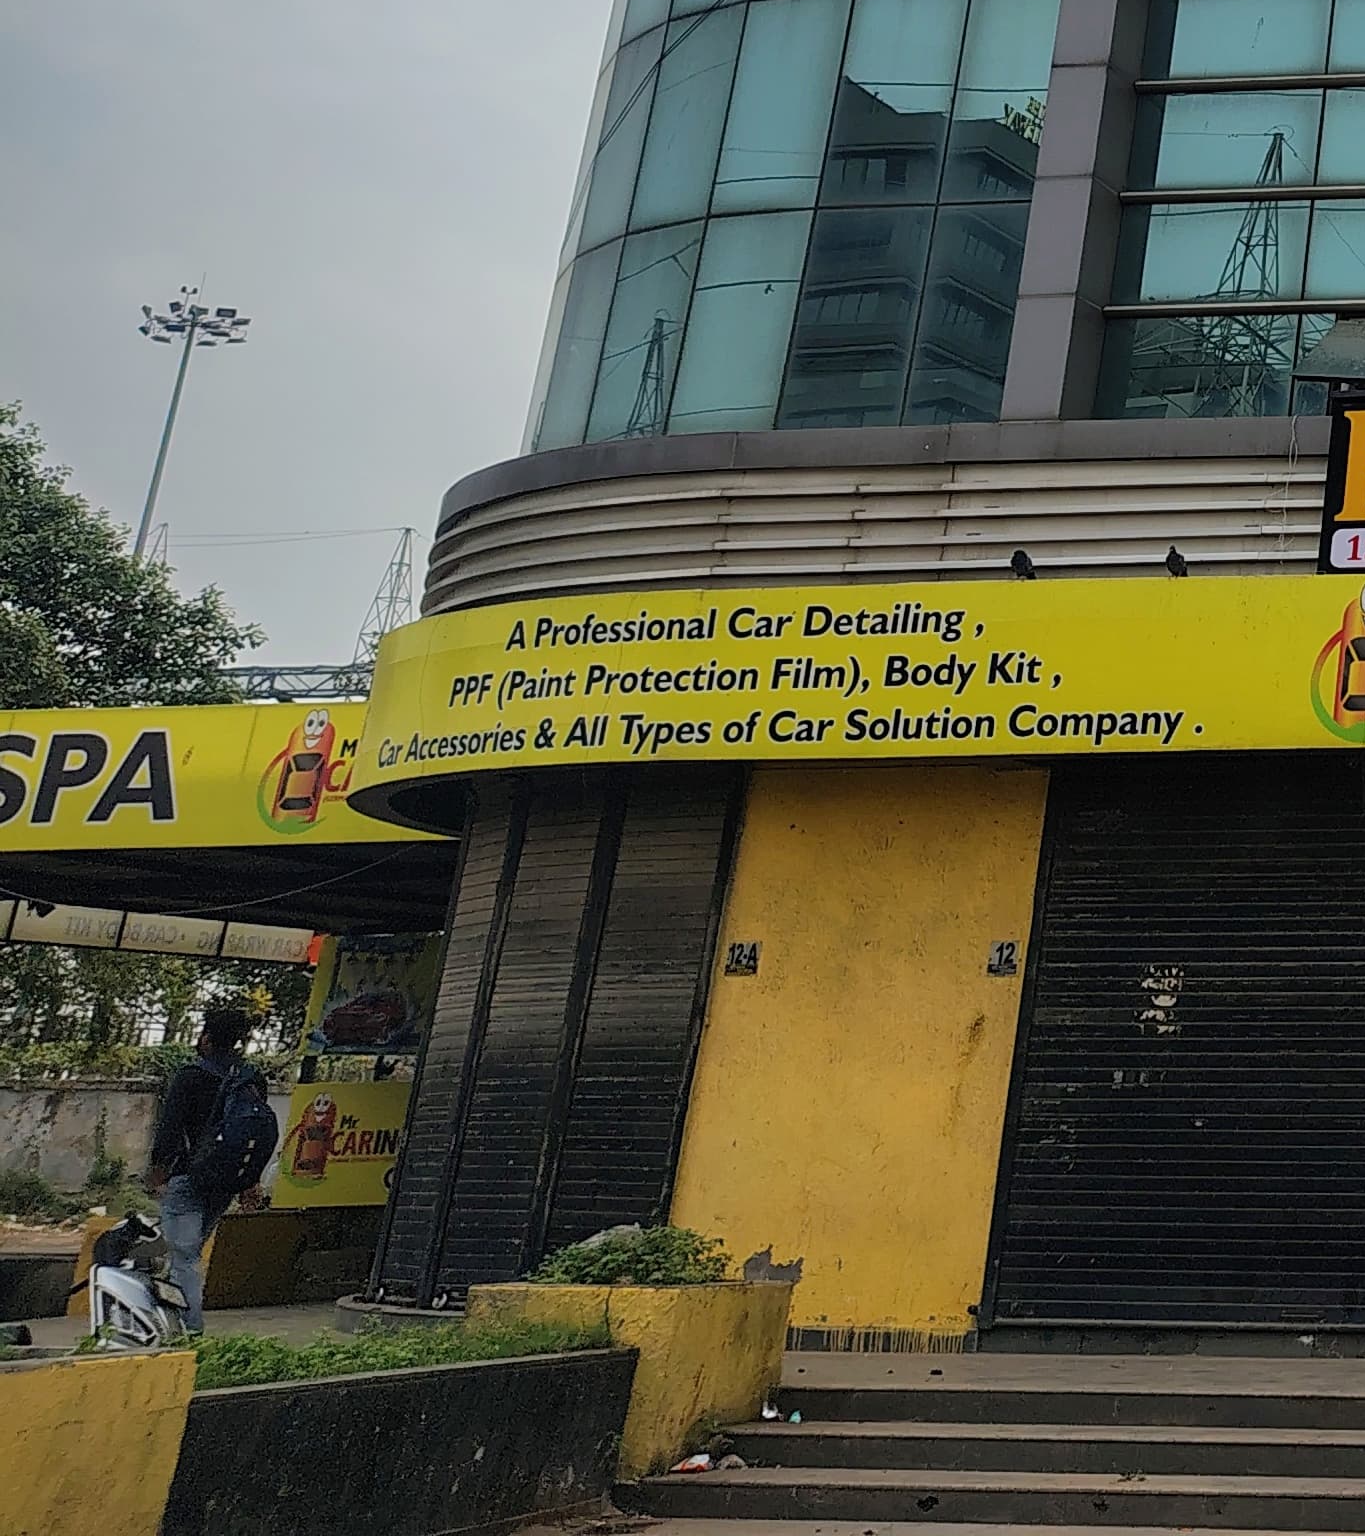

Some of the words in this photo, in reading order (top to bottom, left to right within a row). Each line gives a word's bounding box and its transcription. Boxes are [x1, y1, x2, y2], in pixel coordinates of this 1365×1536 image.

[506, 621, 525, 651] A
[534, 610, 716, 650] Professional
[728, 608, 792, 640] Car
[802, 603, 964, 644] Detailing
[449, 678, 495, 708] PPF
[496, 671, 577, 711] (Paint
[583, 664, 760, 696] Protection
[771, 657, 871, 697] Film),
[884, 654, 976, 695] Body
[987, 652, 1042, 686] Kit
[378, 740, 404, 769] Car
[404, 724, 527, 762] Accessories
[534, 719, 556, 749] &
[563, 715, 607, 749] All
[618, 714, 711, 754] Types
[723, 711, 760, 744] of
[769, 710, 834, 744] Car
[844, 707, 995, 742] Solution
[1008, 704, 1184, 748] Company
[0, 730, 177, 825] SPA
[996, 942, 1016, 966] 12
[330, 1128, 399, 1157] CARIN
